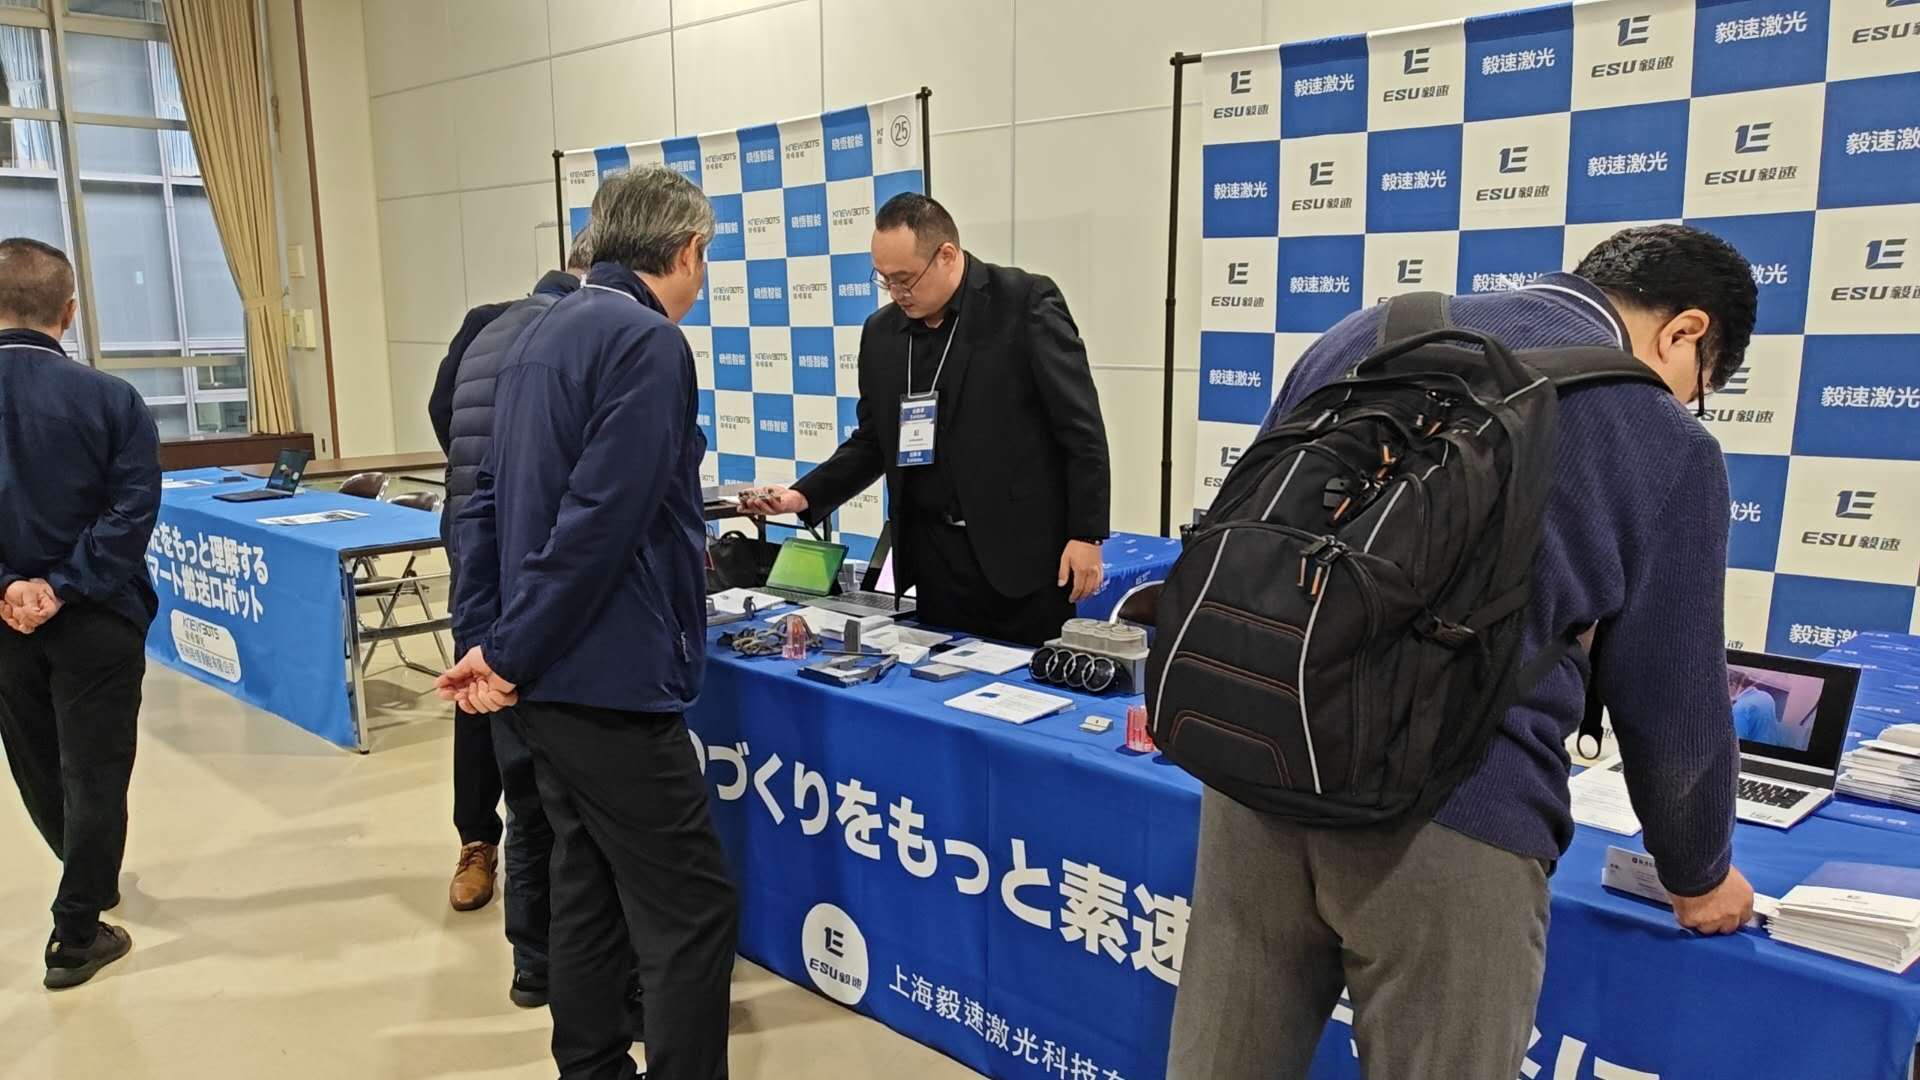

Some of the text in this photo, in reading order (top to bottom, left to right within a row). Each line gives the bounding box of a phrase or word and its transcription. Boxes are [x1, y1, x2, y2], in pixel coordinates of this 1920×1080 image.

[1715, 11, 1808, 44] 毅速激光
[1481, 48, 1555, 76] 毅速激光
[1294, 73, 1354, 97] 毅速激光
[893, 119, 909, 143] 25
[1587, 152, 1668, 177] 毅速激光
[1214, 182, 1267, 200] 毅速激光
[1381, 169, 1446, 192] 毅速激光
[1289, 275, 1350, 294] 毅速激光
[1209, 369, 1261, 388] 毅速激光
[1821, 386, 1920, 408] 毅速激光
[145, 554, 264, 623] マート搬送ロボット
[688, 728, 1192, 987] づくりをもっと素速
